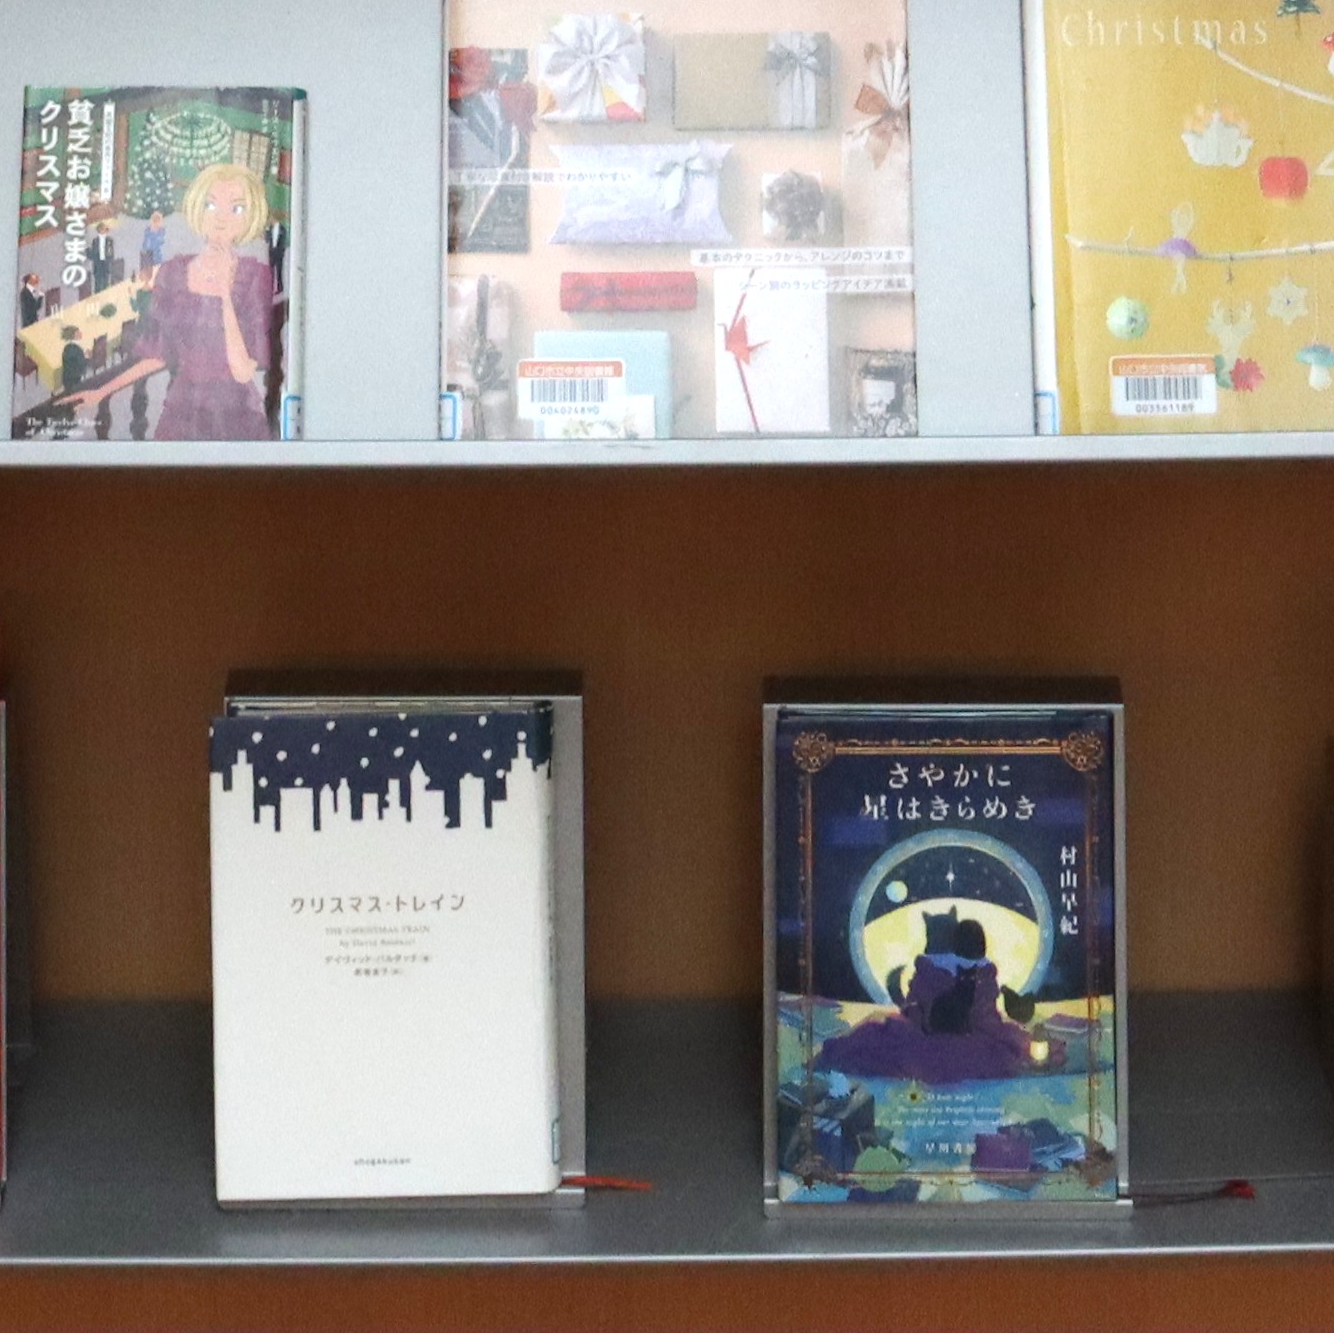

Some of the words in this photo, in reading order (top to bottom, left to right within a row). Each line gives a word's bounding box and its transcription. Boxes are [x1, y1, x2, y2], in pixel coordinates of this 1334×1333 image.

[1059, 10, 1269, 47] Christmas
[34, 99, 62, 229] クリスマス
[62, 98, 96, 289] 貧乏お嬢さまの
[887, 762, 1012, 790] さやかに
[860, 793, 1037, 823] 星はきらめき
[290, 894, 465, 914] クリスマス・トレイン
[1059, 844, 1079, 937] 村山早紀
